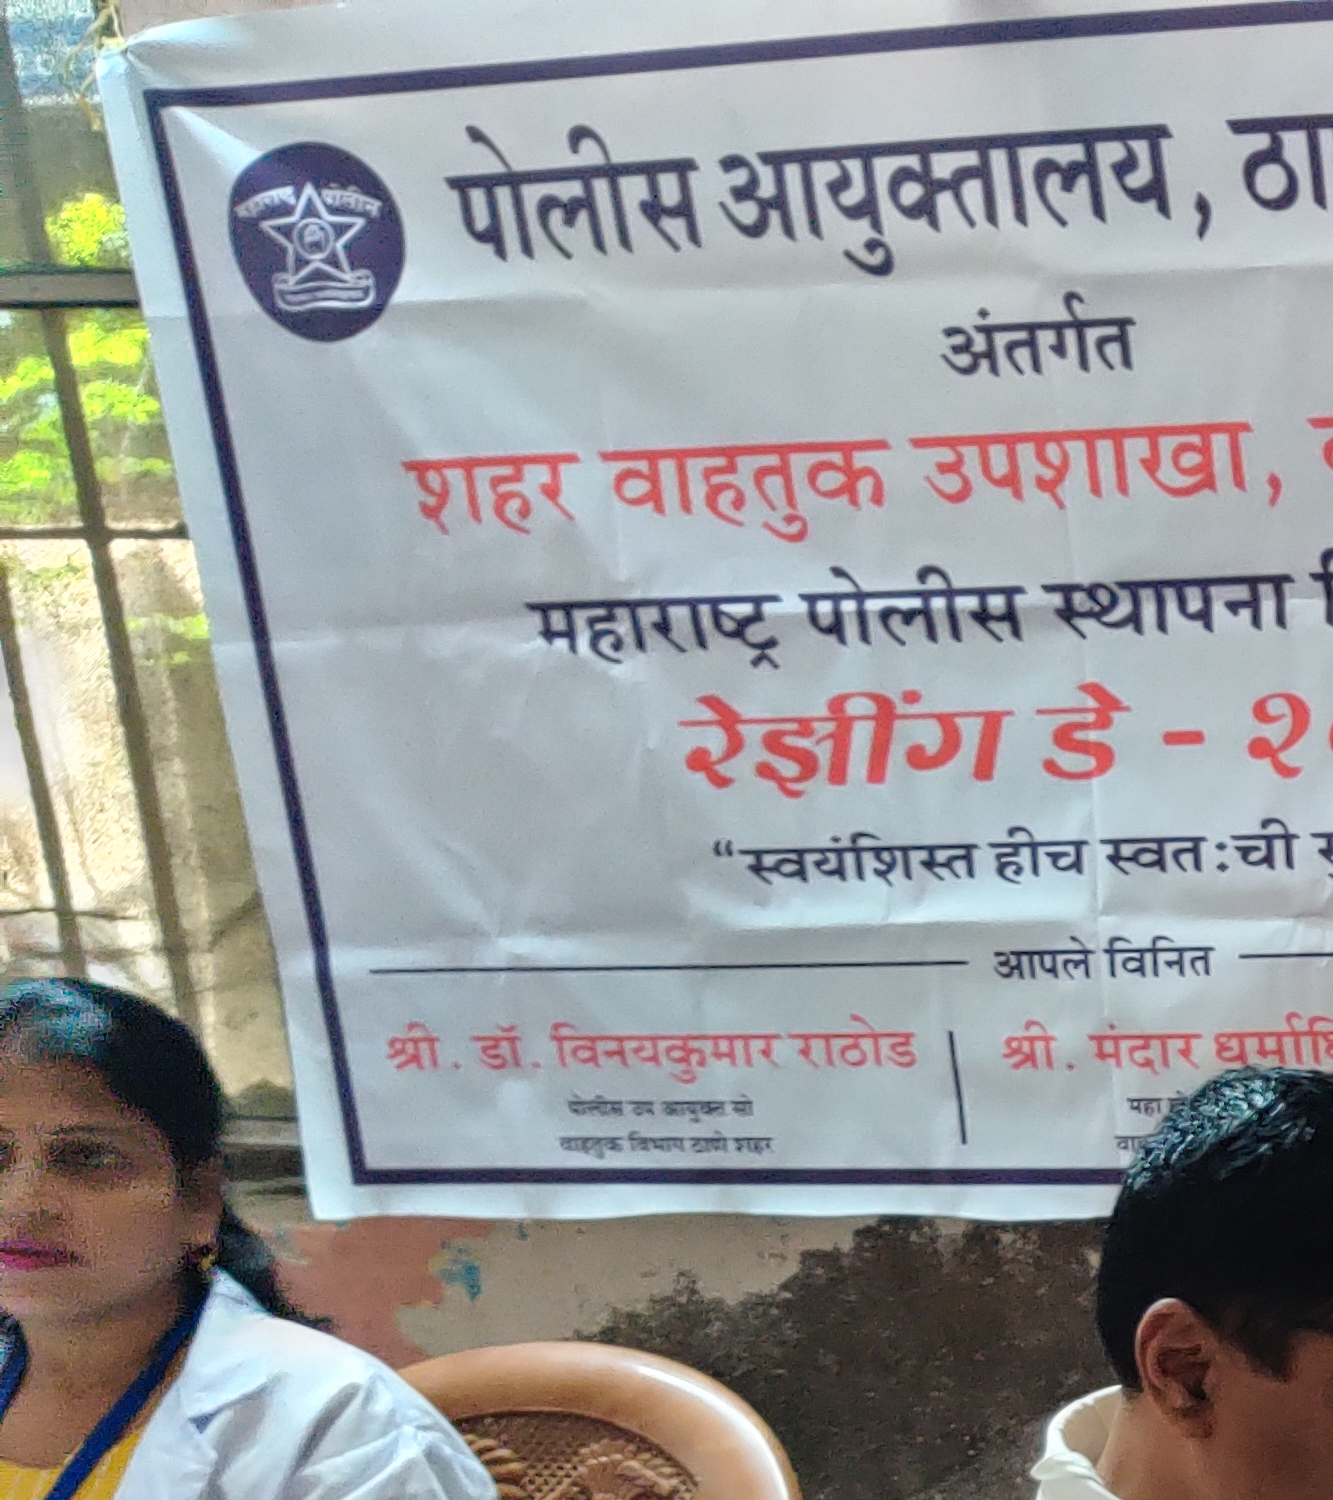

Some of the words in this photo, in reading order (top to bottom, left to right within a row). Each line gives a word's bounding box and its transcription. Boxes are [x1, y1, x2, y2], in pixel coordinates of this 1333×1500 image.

[443, 124, 702, 262] पोलीस
[940, 290, 1137, 377] अंतर्गत
[401, 452, 581, 534] शहर
[597, 438, 892, 544] वाहतुक
[524, 594, 782, 669] महाराष्ट्र
[797, 564, 1026, 647] पोलीस
[1040, 573, 1296, 640] स्थापना
[1035, 681, 1130, 781] डे
[1162, 730, 1206, 746] -
[989, 826, 1090, 885] हीच
[993, 935, 1097, 980] आपले
[1101, 935, 1216, 978] विनित
[549, 1022, 784, 1085] विनयकुमार
[787, 1013, 917, 1069] राठोड
[1087, 1023, 1203, 1075] मंदार
